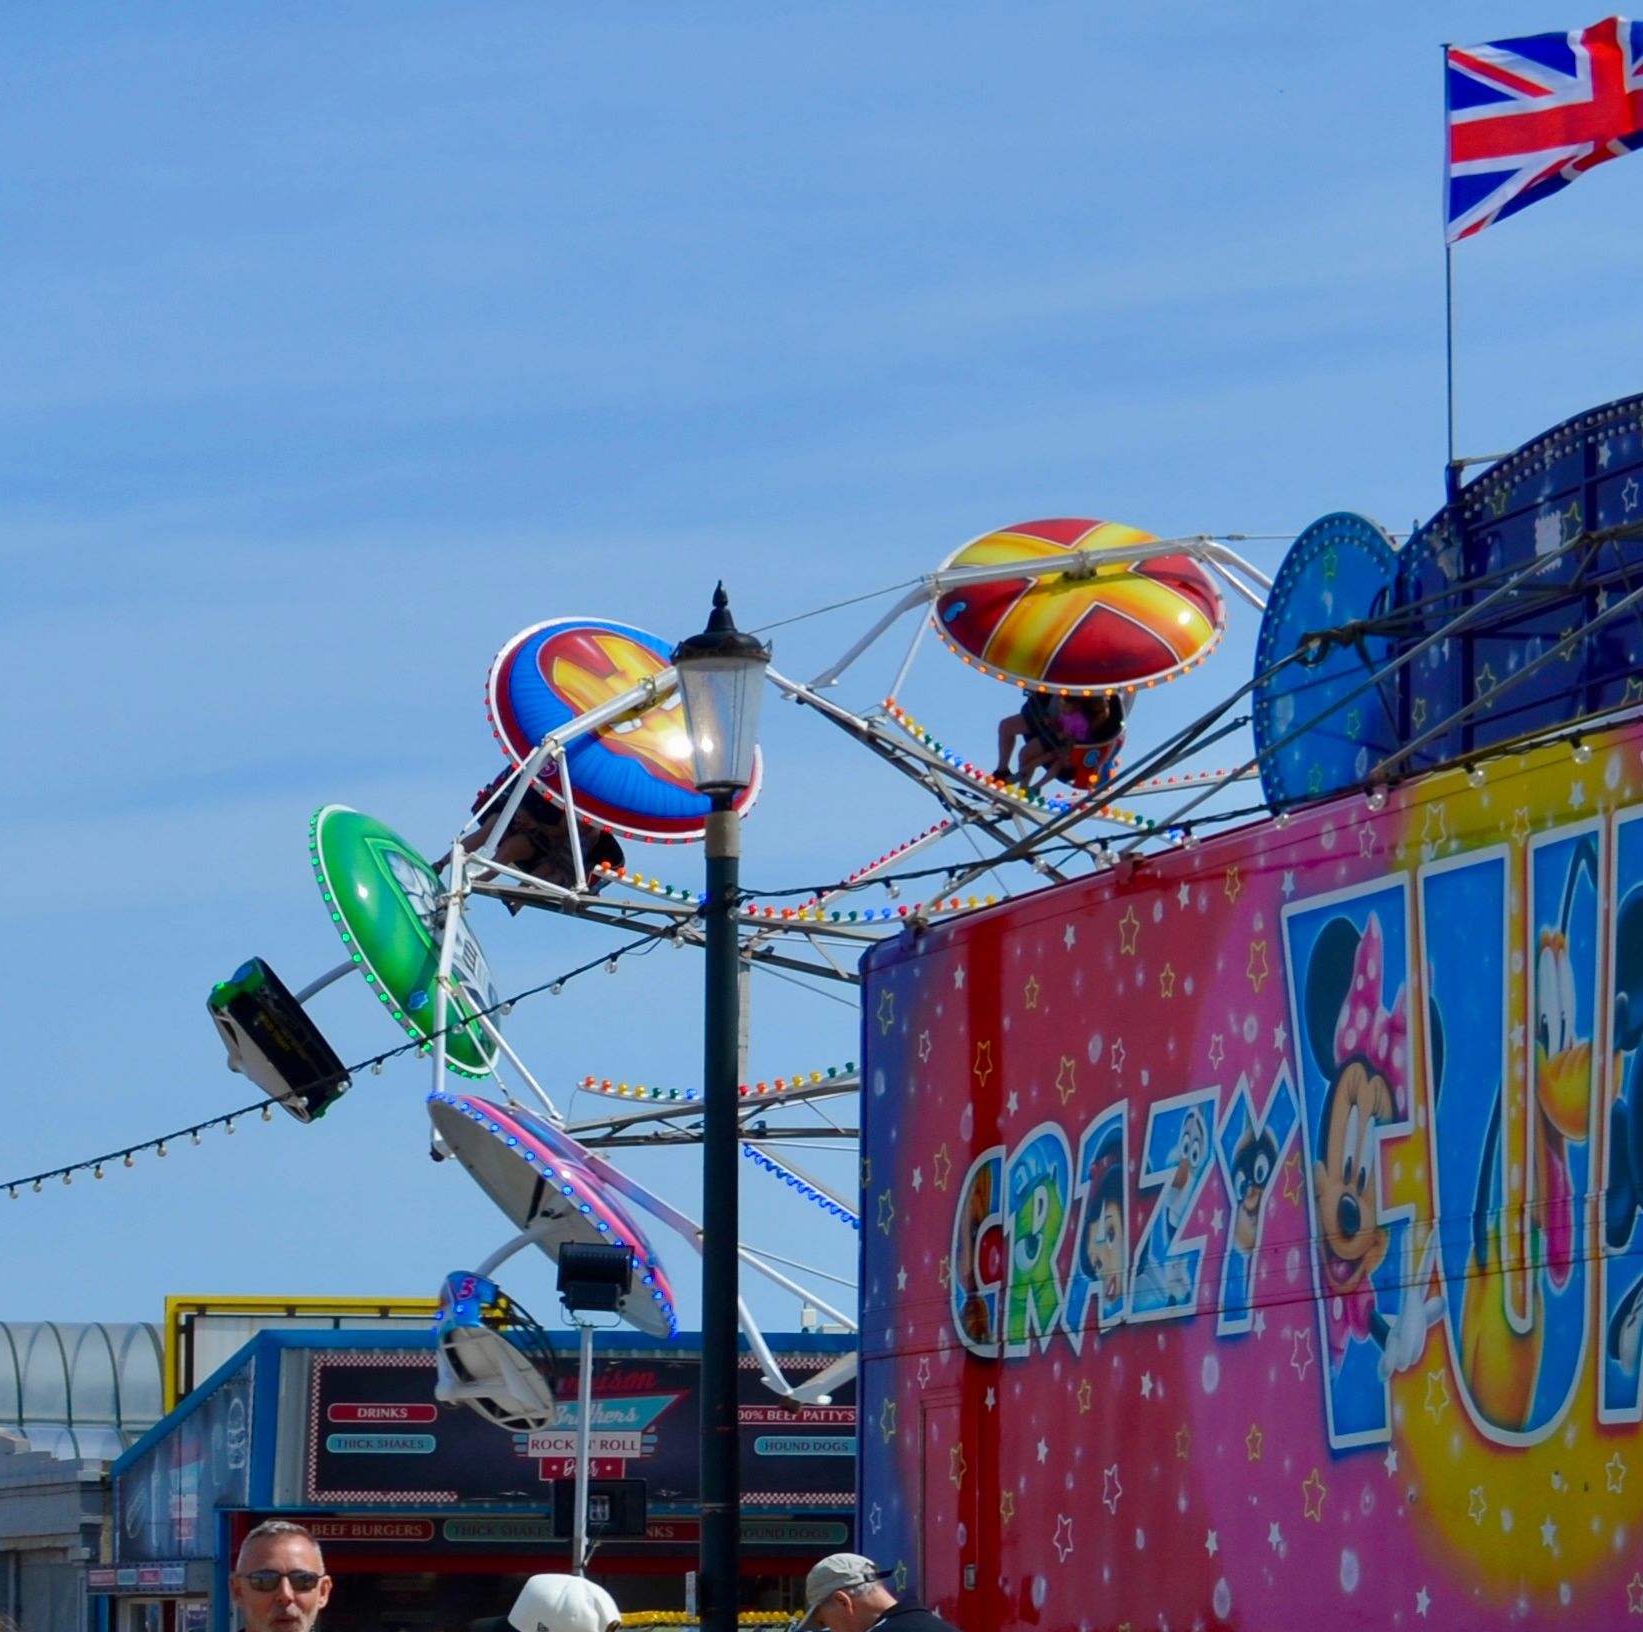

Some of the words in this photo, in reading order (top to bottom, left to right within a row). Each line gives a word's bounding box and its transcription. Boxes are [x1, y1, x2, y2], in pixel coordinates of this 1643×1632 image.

[952, 1056, 1300, 1358] CRAZY
[1281, 805, 1643, 1450] FU
[456, 1277, 476, 1300] 3
[357, 1407, 408, 1418] DRINKS
[738, 1410, 764, 1421] 00%
[803, 1410, 856, 1421] PATTY'S
[337, 1439, 373, 1449] THICK
[377, 1439, 424, 1449] SHAKES
[531, 1439, 574, 1450] ROCK
[600, 1439, 639, 1450] ROLL
[765, 1441, 810, 1451] HOUND
[813, 1441, 849, 1451] DOGS
[312, 1524, 347, 1536] BEEF
[351, 1524, 423, 1536] BURGERS
[454, 1526, 495, 1537] THICK
